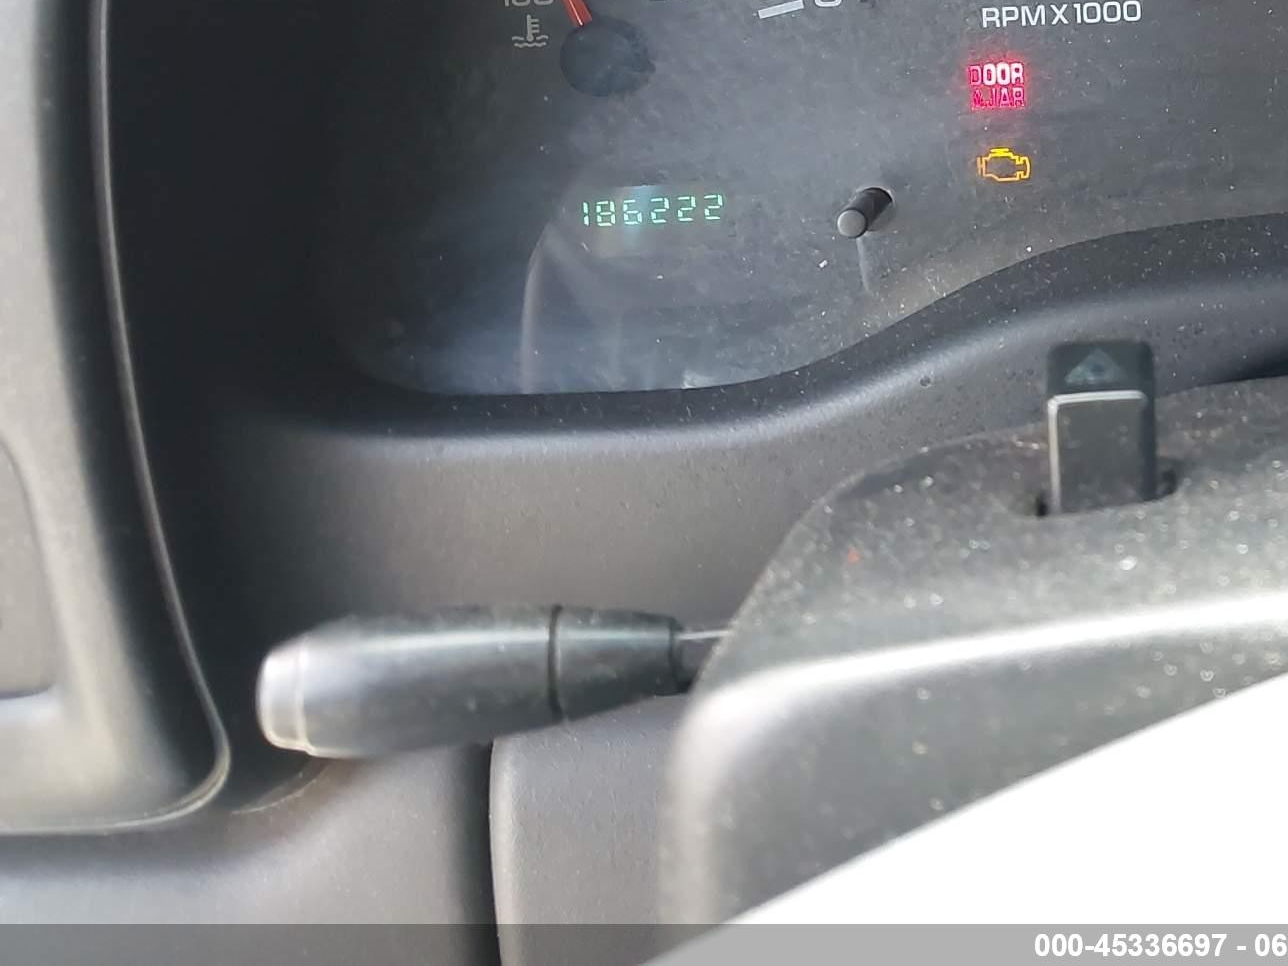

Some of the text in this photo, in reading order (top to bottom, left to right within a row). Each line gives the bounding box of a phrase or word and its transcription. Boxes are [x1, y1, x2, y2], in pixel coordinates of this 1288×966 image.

[982, 0, 1142, 28] RPM X 1000
[970, 62, 1024, 85] DOOR
[582, 194, 723, 226] 186222
